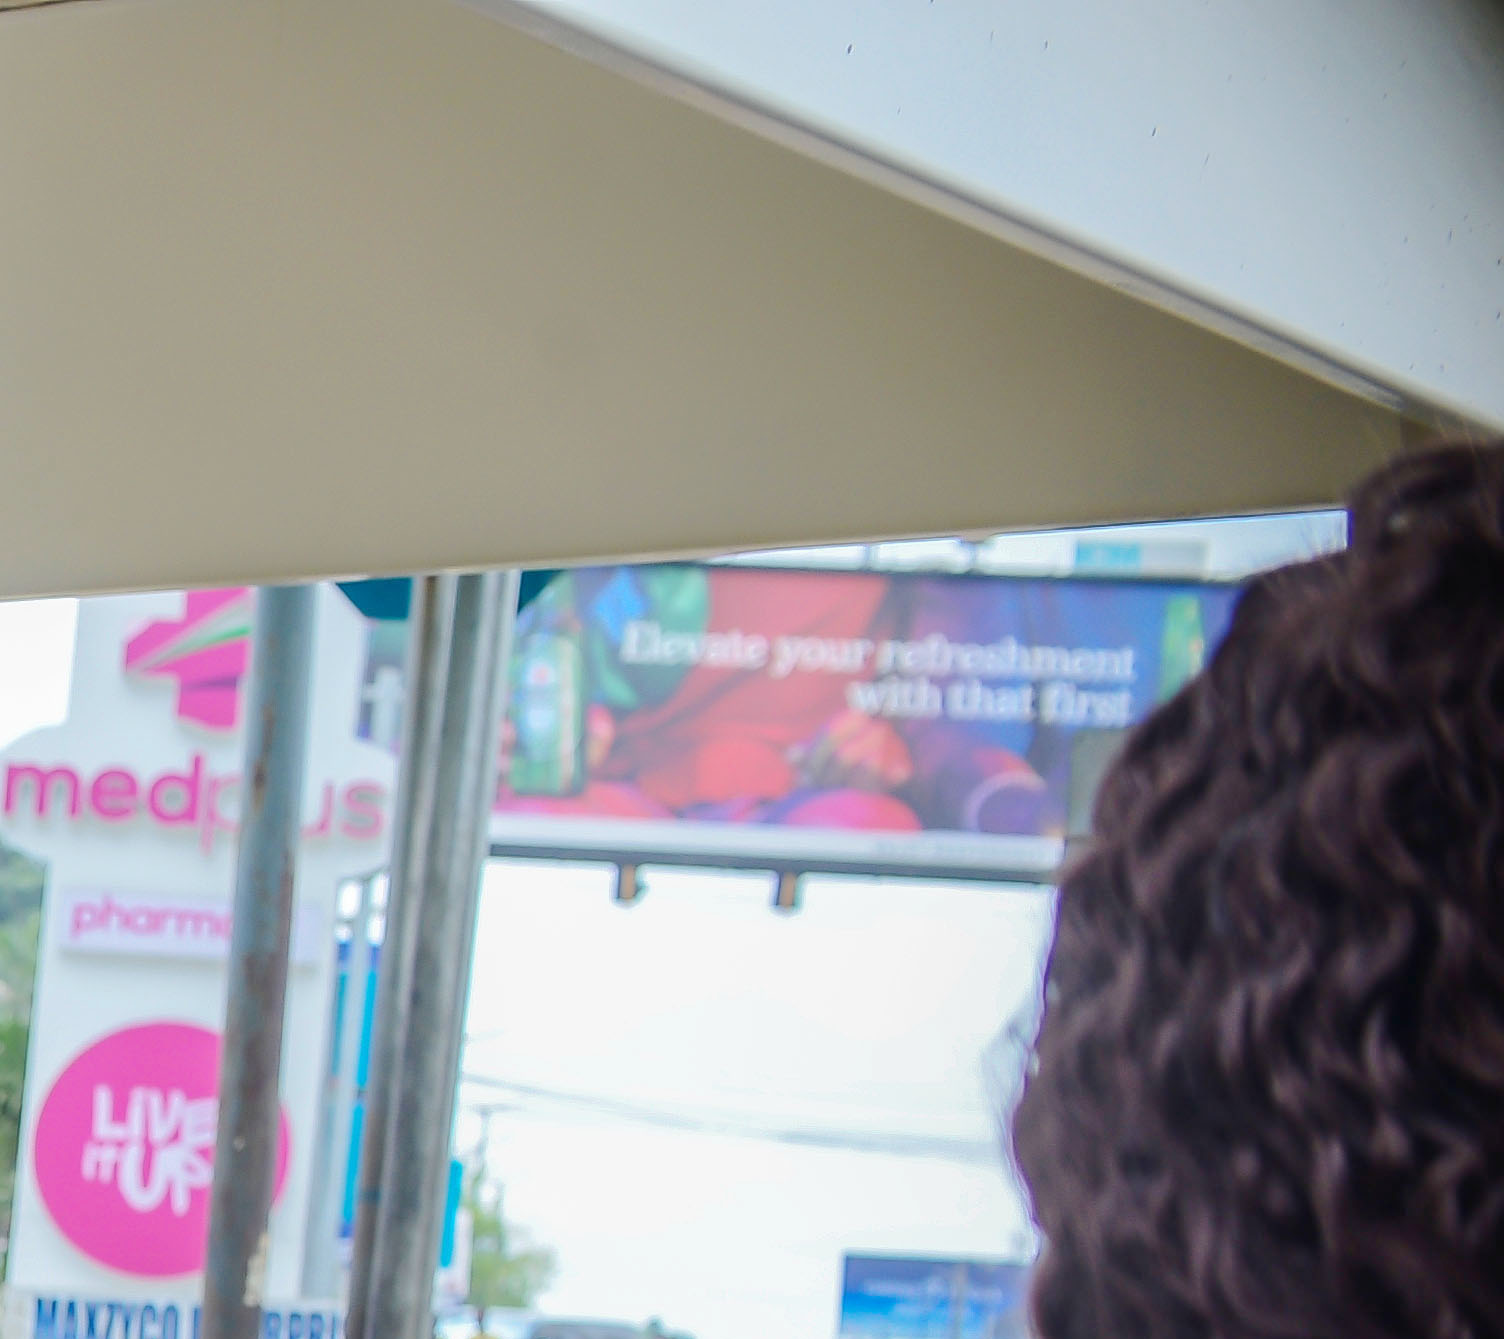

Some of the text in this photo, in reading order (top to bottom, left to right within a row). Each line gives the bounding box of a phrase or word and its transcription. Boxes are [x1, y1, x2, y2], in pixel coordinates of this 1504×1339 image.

[620, 619, 1137, 682] Elevate your refreshment
[845, 675, 1134, 728] with that first
[2, 753, 388, 856] medpus
[68, 893, 232, 940] pharm
